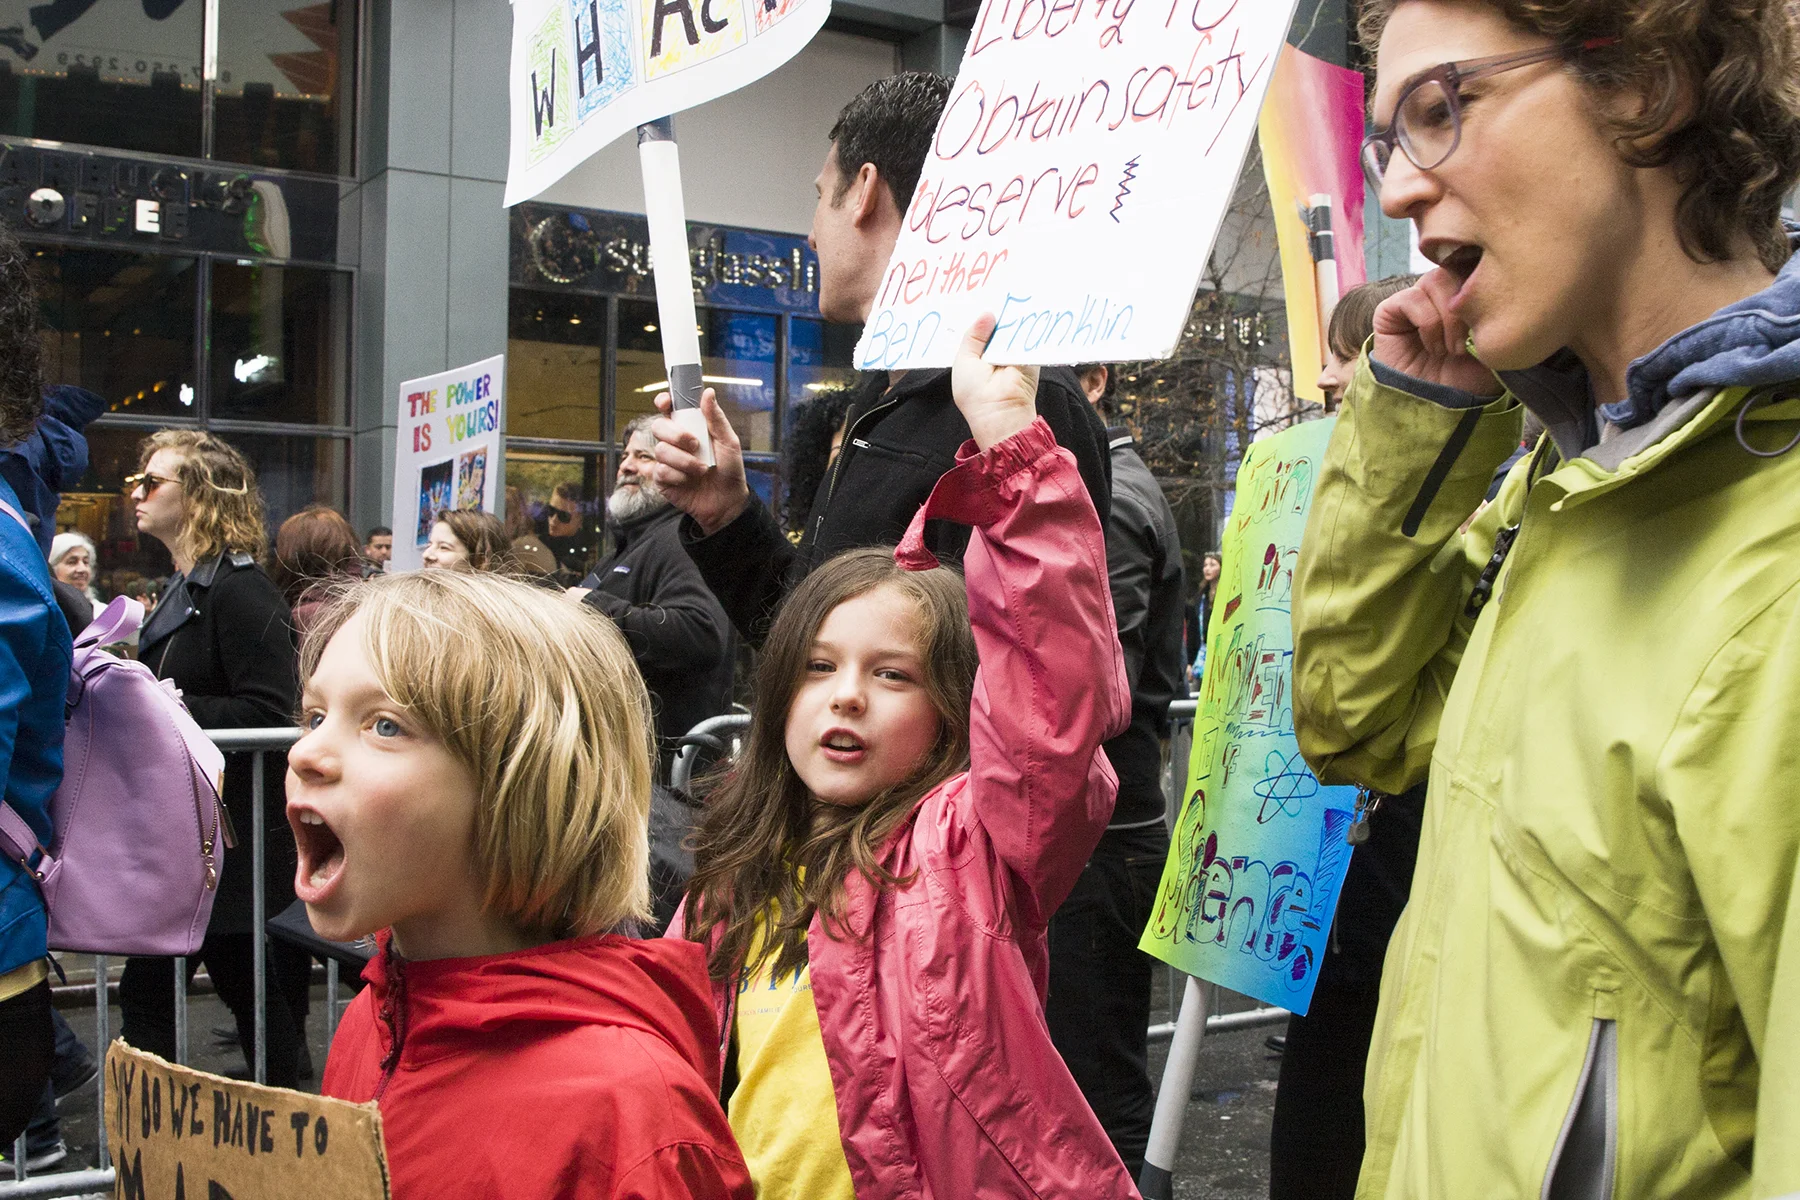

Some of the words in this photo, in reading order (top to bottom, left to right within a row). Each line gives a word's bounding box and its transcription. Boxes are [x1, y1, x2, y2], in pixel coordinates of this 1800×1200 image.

[936, 76, 1110, 160] Obtain
[1108, 27, 1269, 157] safety
[910, 163, 1099, 244] deserve
[605, 236, 789, 297] suglass
[879, 249, 1009, 308] neither
[862, 310, 941, 369] Ben
[984, 293, 1133, 353] Franklin
[407, 389, 438, 418] THE
[446, 373, 491, 409] POWER
[413, 423, 432, 453] IS
[446, 399, 499, 445] YOURS!
[141, 1068, 162, 1140] DO
[168, 1074, 205, 1140] WE
[213, 1090, 276, 1156] HAVE
[290, 1111, 329, 1159] TO
